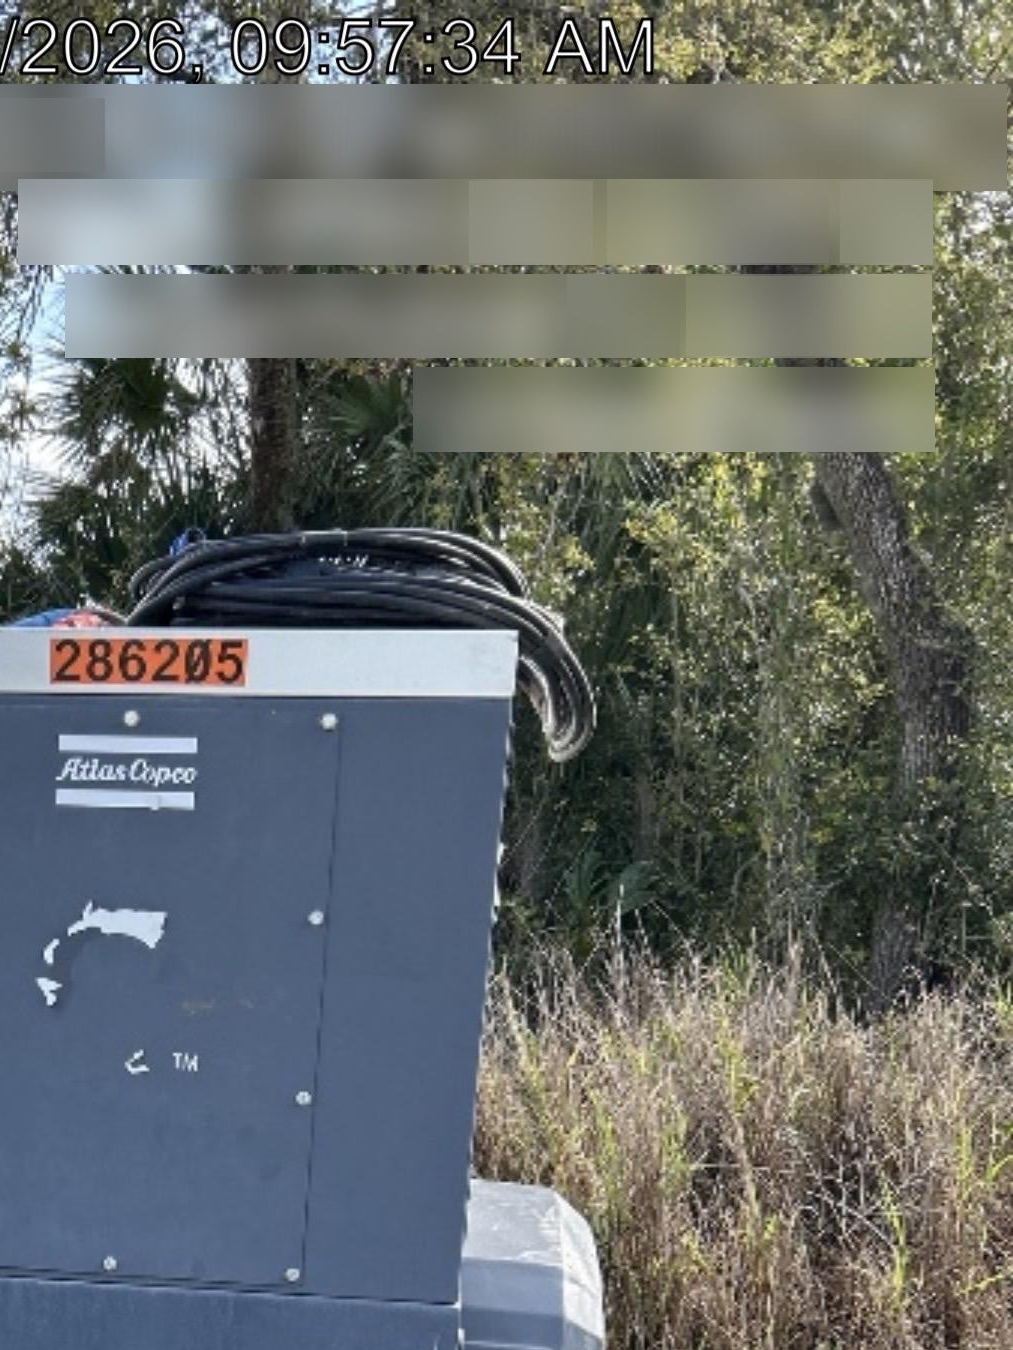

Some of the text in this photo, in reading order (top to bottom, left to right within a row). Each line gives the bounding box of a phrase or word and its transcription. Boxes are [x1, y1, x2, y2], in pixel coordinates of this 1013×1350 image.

[55, 757, 198, 788] Atlas Copco
[172, 1052, 198, 1072] TM
